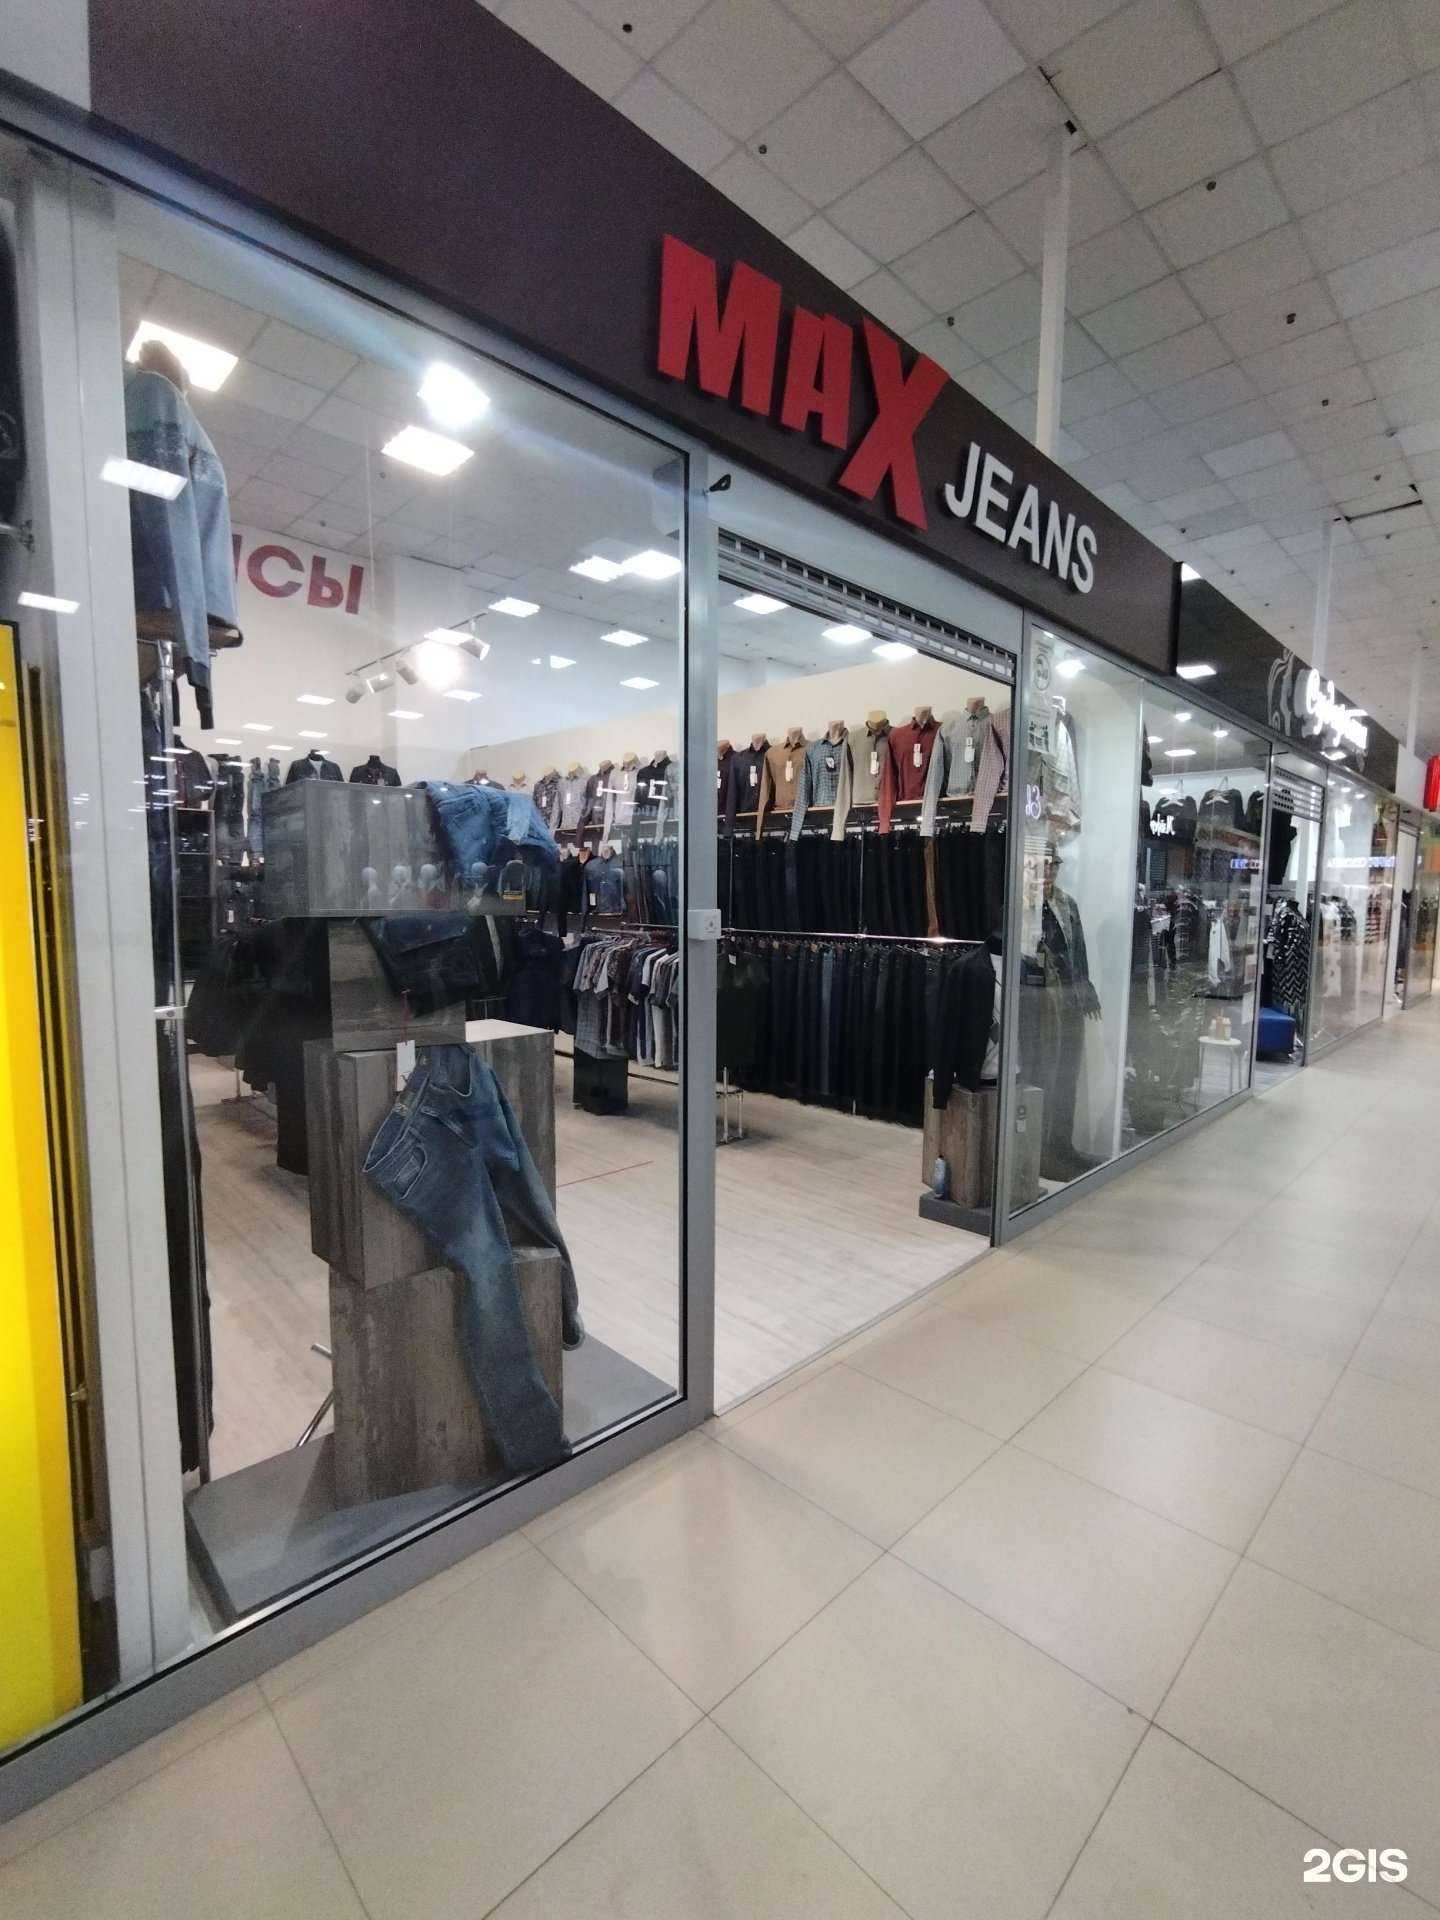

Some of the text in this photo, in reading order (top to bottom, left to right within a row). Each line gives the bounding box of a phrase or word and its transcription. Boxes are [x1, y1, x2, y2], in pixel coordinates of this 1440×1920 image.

[657, 233, 1097, 594] MAX JEANS
[232, 534, 364, 614] СЫ
